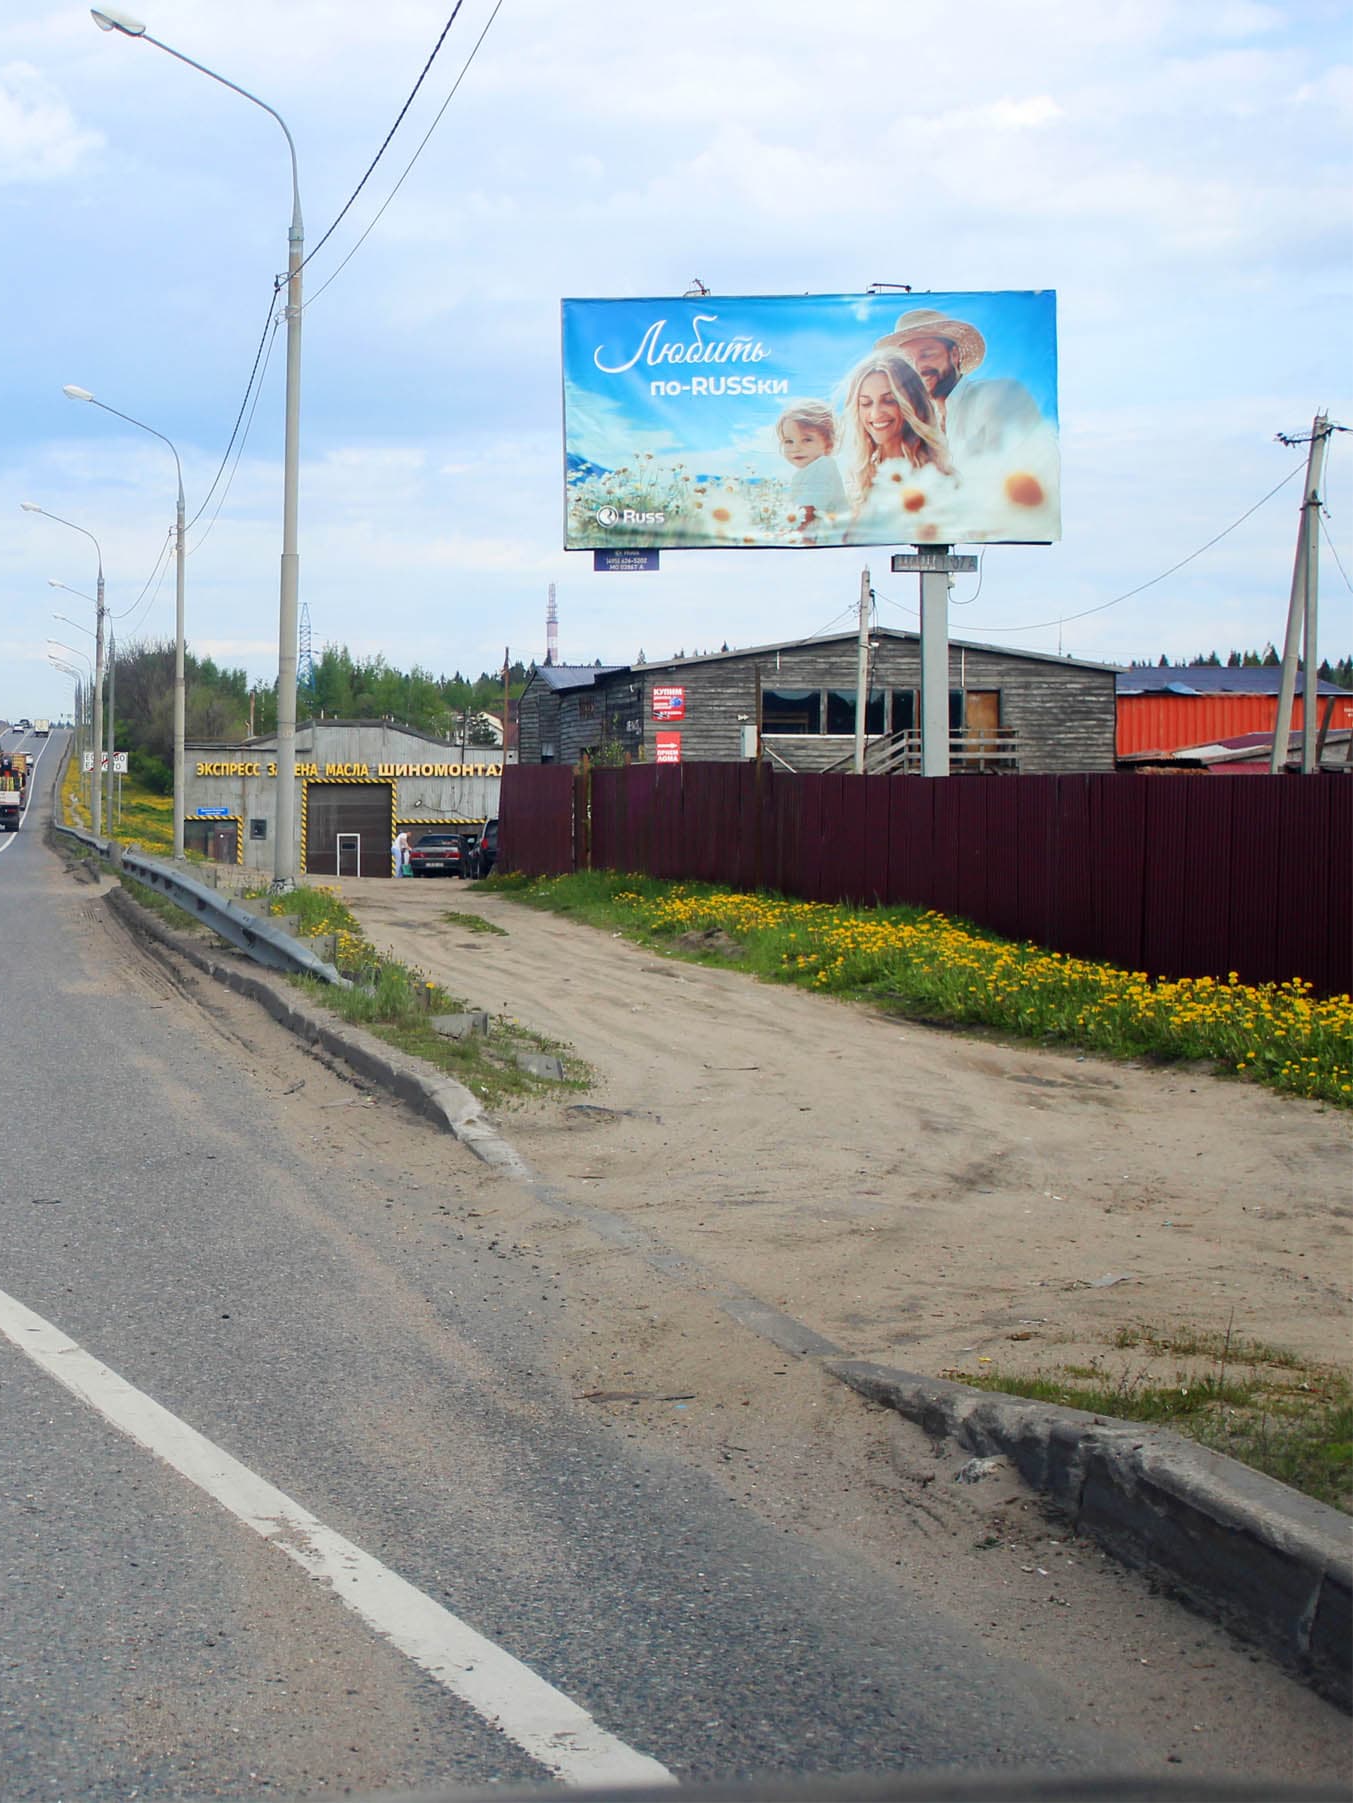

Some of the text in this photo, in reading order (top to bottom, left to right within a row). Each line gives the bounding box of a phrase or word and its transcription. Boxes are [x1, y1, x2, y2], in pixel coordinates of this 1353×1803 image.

[593, 314, 772, 374] Любить
[650, 376, 789, 397] по-RUSSки
[623, 509, 665, 524] Russ
[653, 688, 683, 696] КУПИМ
[196, 762, 261, 776] ЭКСПРЕСС
[267, 763, 319, 777] ЗЕНА
[325, 763, 369, 777] МАСЛА
